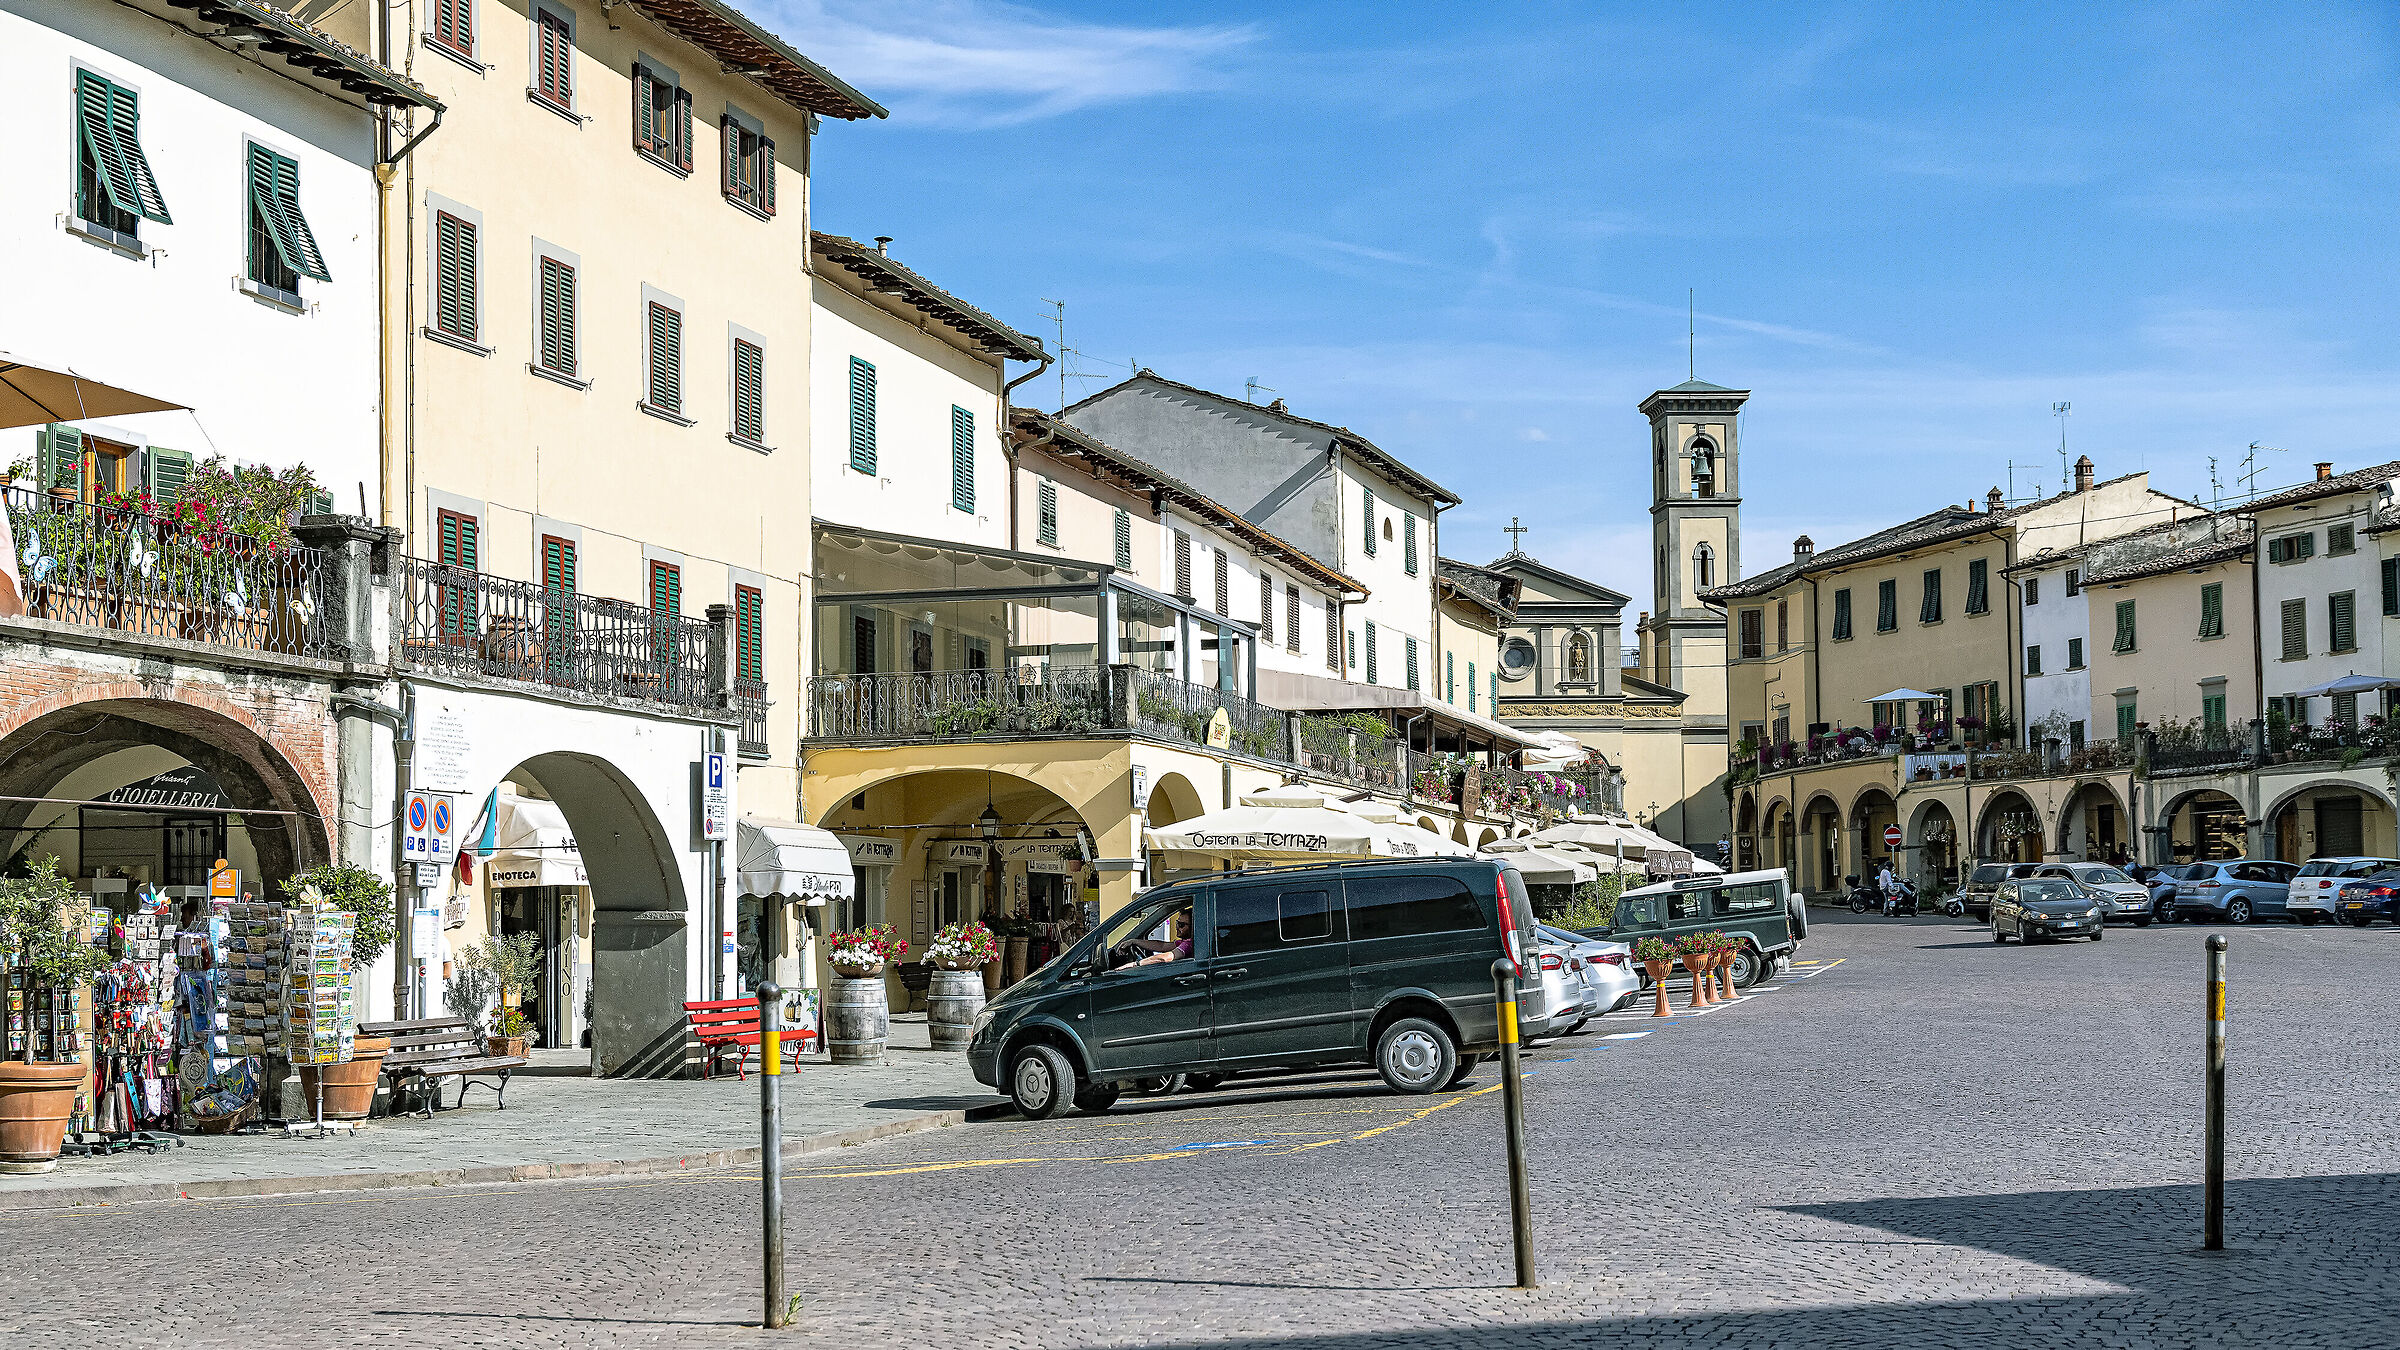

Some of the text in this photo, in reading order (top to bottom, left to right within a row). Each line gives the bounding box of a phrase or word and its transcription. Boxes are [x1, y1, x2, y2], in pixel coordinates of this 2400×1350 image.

[711, 757, 721, 786] P
[109, 787, 219, 809] GIOIELLERIA
[492, 870, 537, 881] ENOTECA
